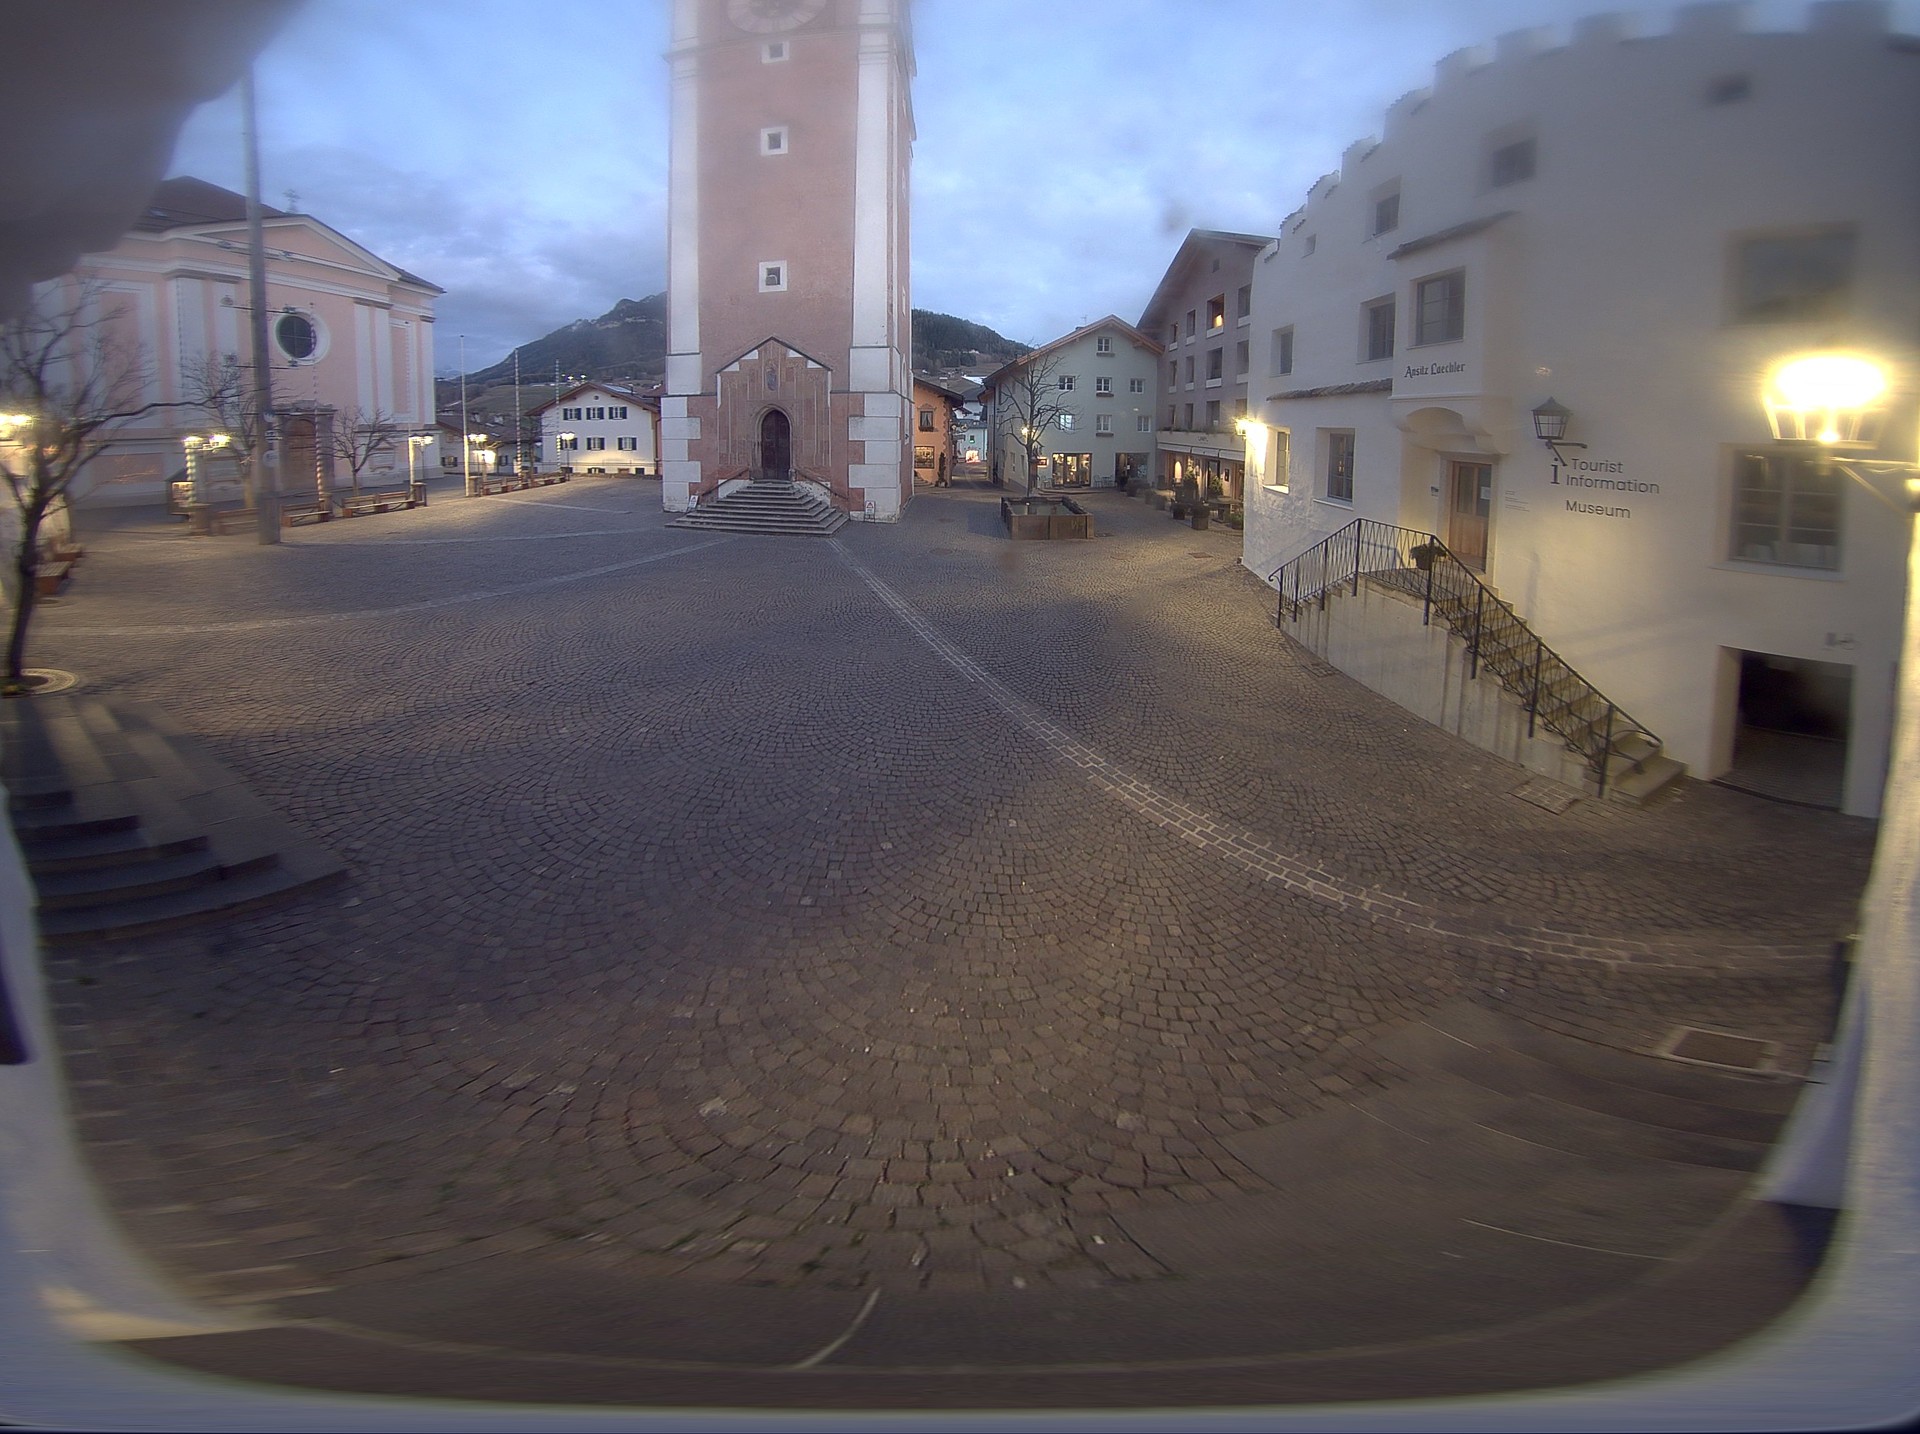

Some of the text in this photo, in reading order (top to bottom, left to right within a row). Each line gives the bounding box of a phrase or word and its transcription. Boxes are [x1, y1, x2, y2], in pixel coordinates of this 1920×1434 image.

[1404, 365, 1429, 379] Ansitz
[1571, 458, 1624, 473] Tourist
[1565, 474, 1660, 494] Information
[1565, 499, 1631, 518] Museum
